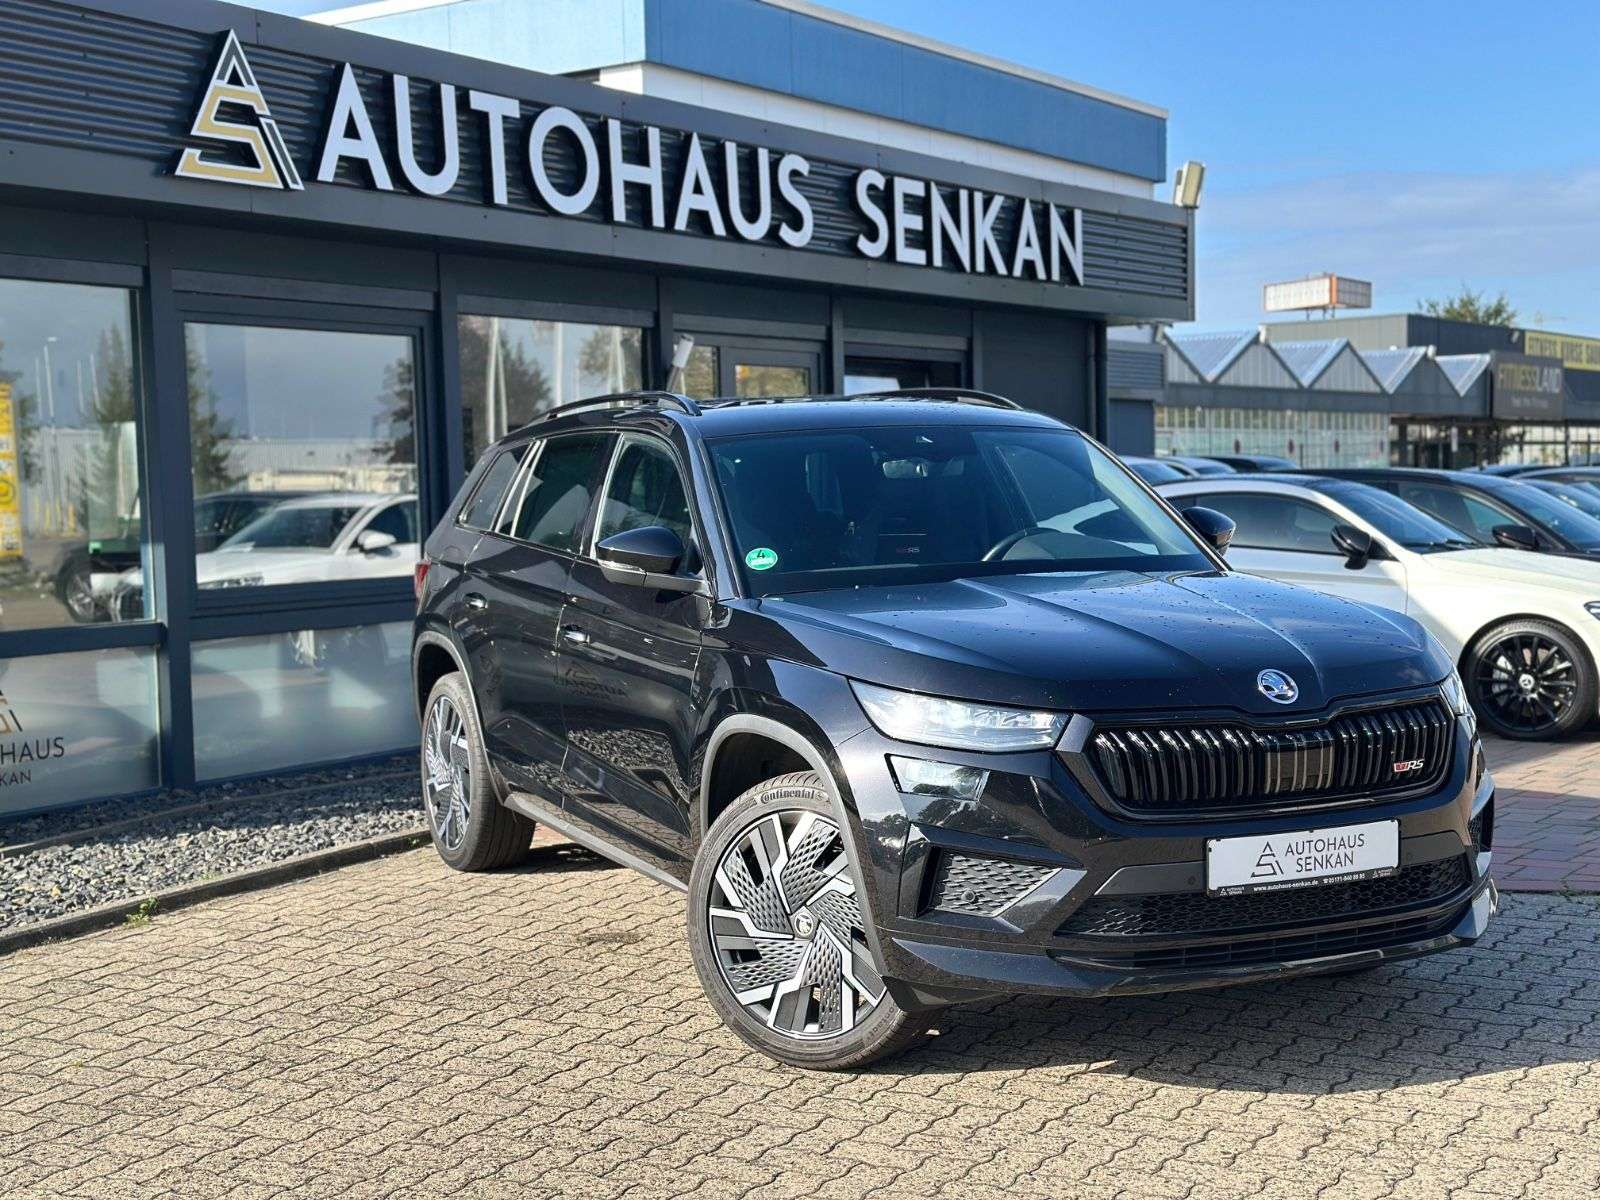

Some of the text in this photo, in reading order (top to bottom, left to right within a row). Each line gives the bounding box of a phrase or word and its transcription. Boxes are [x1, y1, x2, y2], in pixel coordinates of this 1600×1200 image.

[317, 62, 1084, 286] AUTOHAUS SENKAN
[756, 549, 766, 559] 4
[760, 788, 815, 804] Continental
[1284, 833, 1365, 857] AUTOHAUS
[1296, 851, 1354, 873] SENKAN
